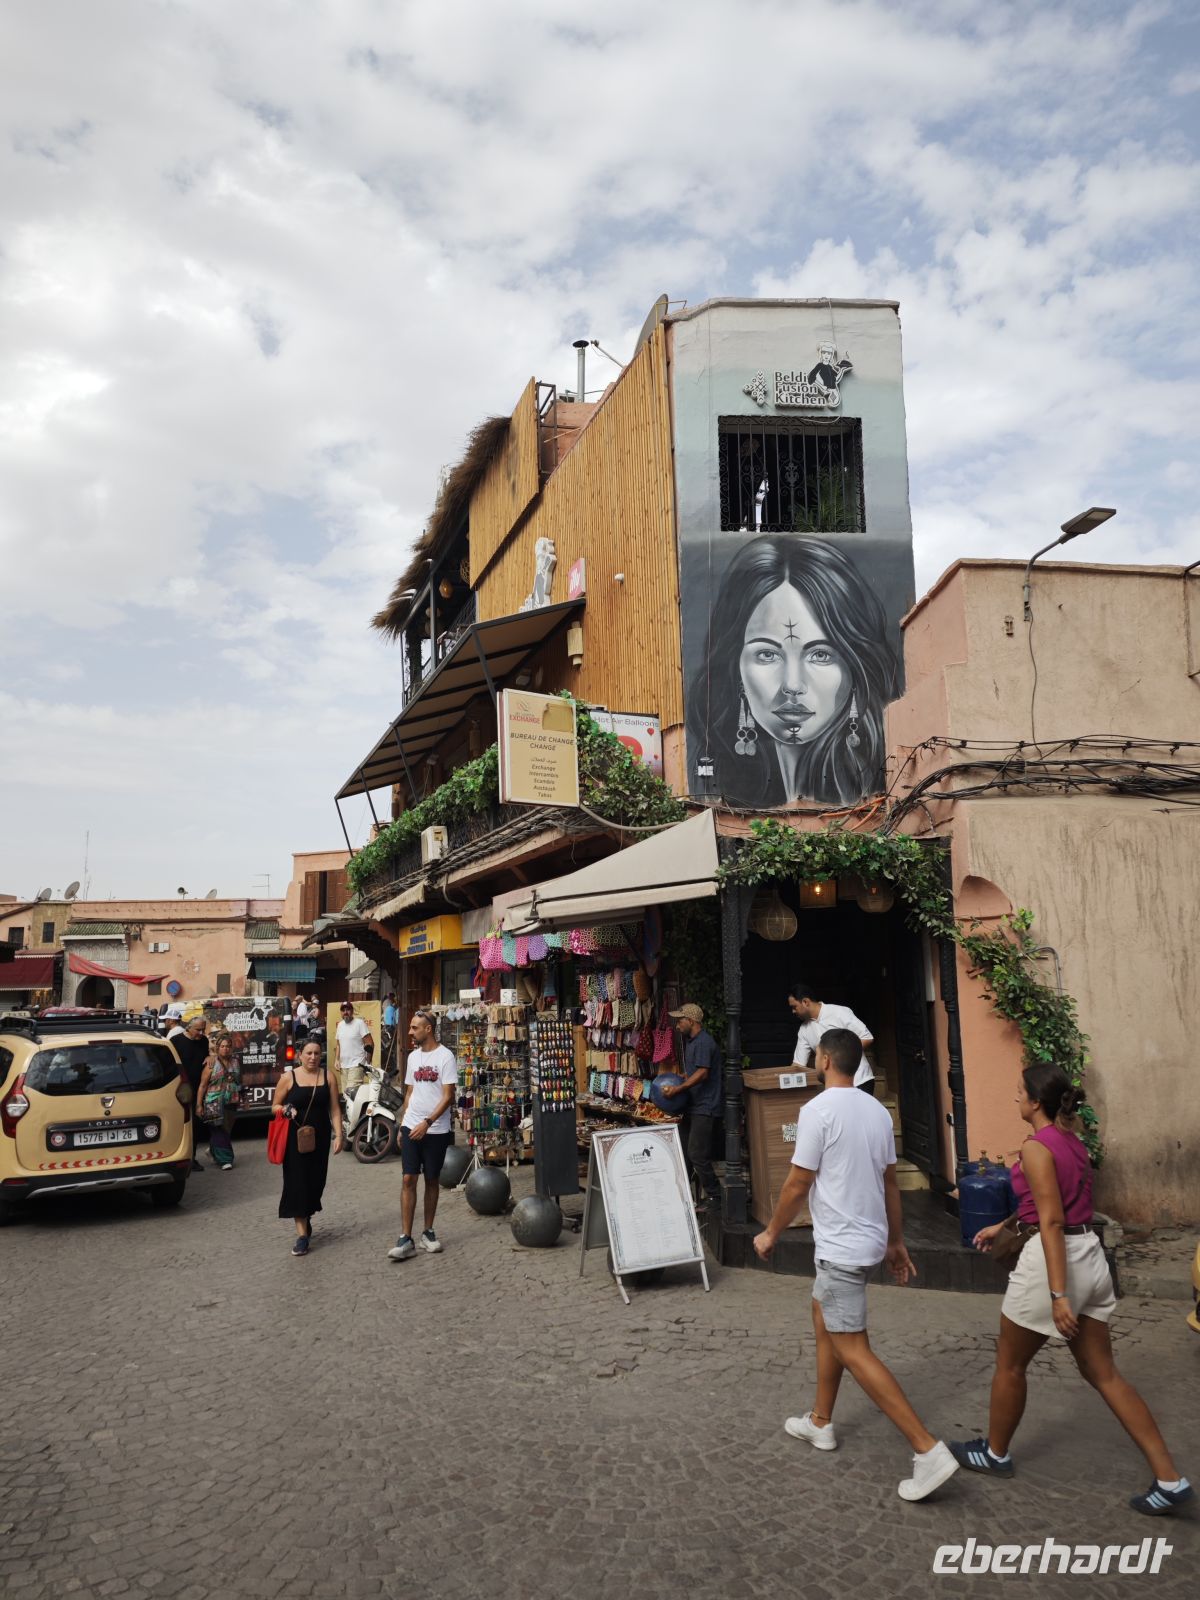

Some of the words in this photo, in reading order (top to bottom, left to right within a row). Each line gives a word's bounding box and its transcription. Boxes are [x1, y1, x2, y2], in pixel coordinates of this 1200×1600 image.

[775, 371, 808, 382] Beldi
[775, 382, 820, 393] Fusion
[775, 393, 826, 405] Kitchen
[625, 718, 659, 728] Balloons
[510, 732, 537, 741] BUREAU
[548, 736, 575, 746] CHANGE
[530, 742, 556, 751] CHANGE
[122, 1129, 133, 1139] 26
